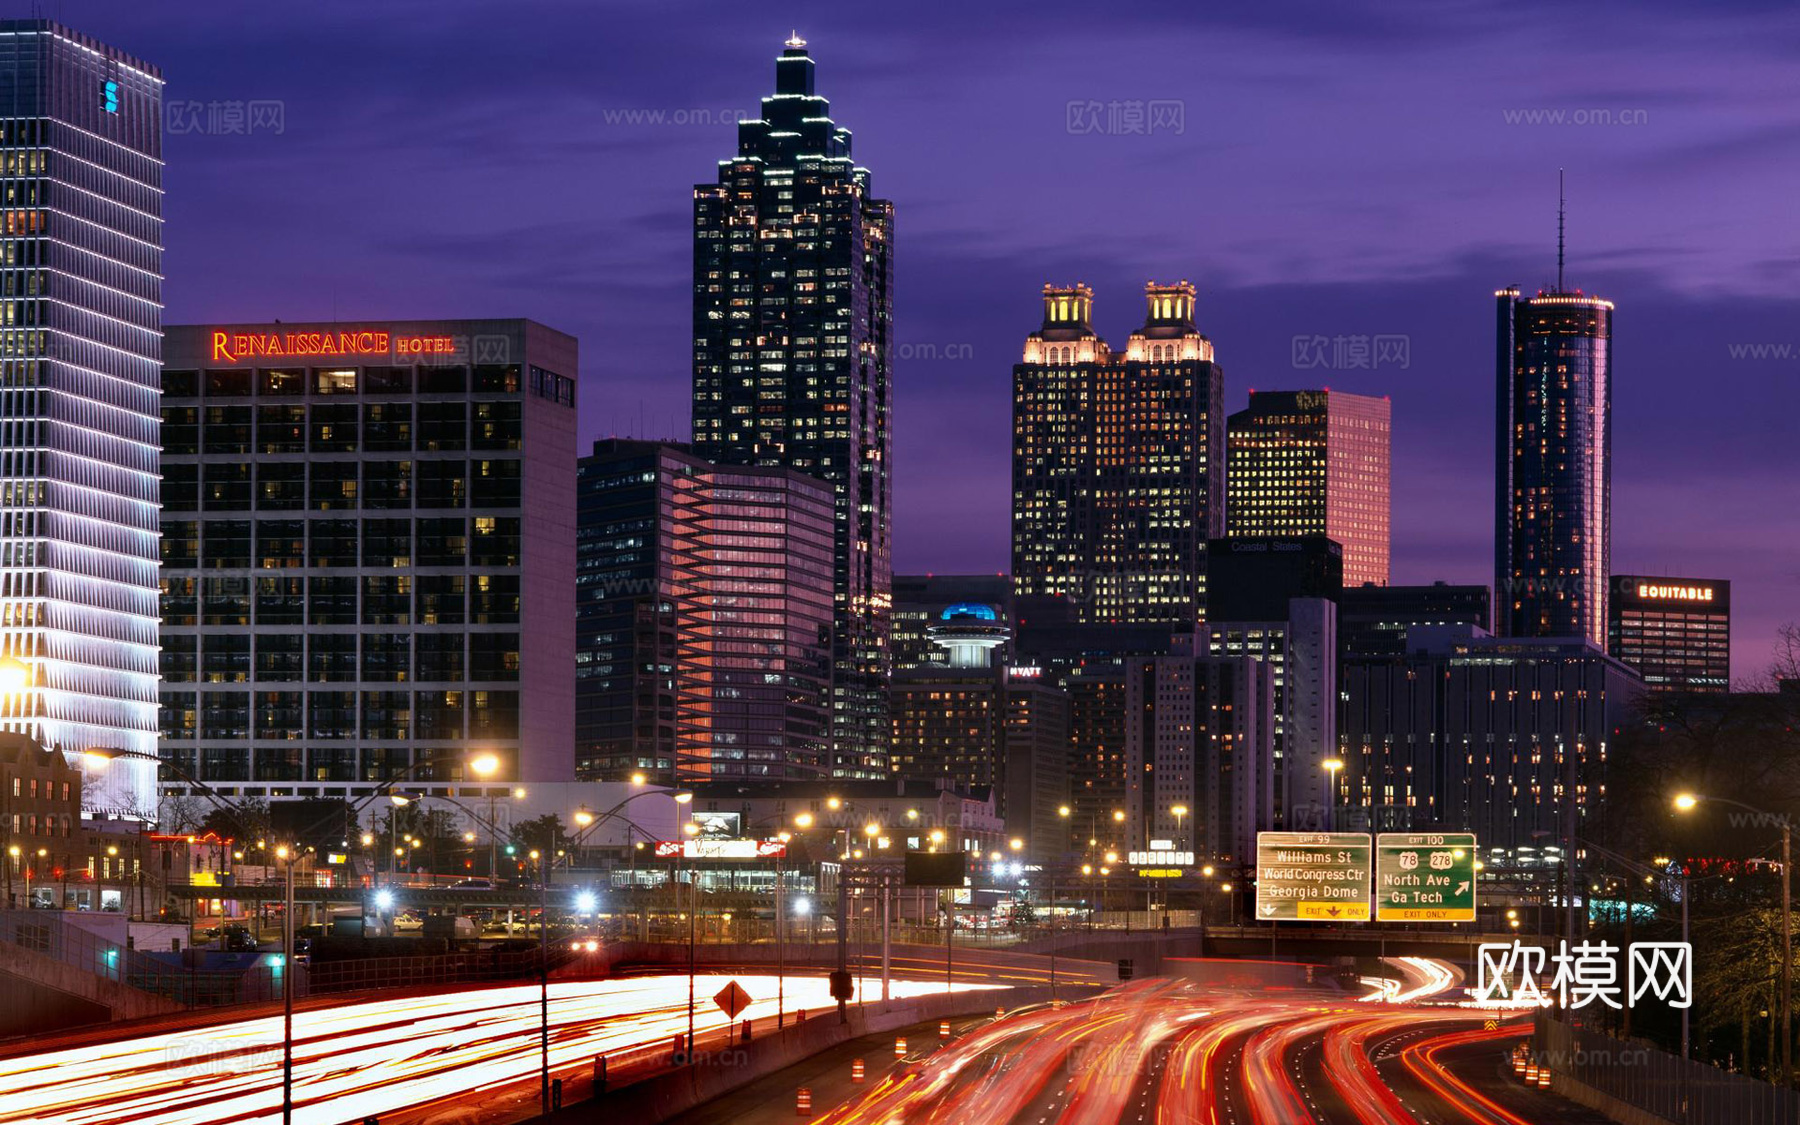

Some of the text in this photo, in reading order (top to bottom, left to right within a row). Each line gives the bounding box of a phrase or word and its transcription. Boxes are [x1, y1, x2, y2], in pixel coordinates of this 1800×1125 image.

[213, 331, 455, 362] RENAISSANCE HOTEL
[1231, 541, 1303, 552] Coastal States
[1639, 585, 1713, 600] EQUITABLE
[1010, 667, 1041, 677] HYATT
[1299, 835, 1330, 844] EXIT 99
[1427, 836, 1444, 845] 100
[1277, 851, 1352, 863] Williams St
[1401, 855, 1417, 866] 78
[1432, 855, 1451, 866] 278
[1264, 868, 1364, 883] World Congress Ctr
[1384, 874, 1450, 886] North Ave
[1269, 885, 1358, 900] Georgia Dome
[1391, 891, 1443, 903] Ga Tech
[1347, 908, 1365, 916] ONLY
